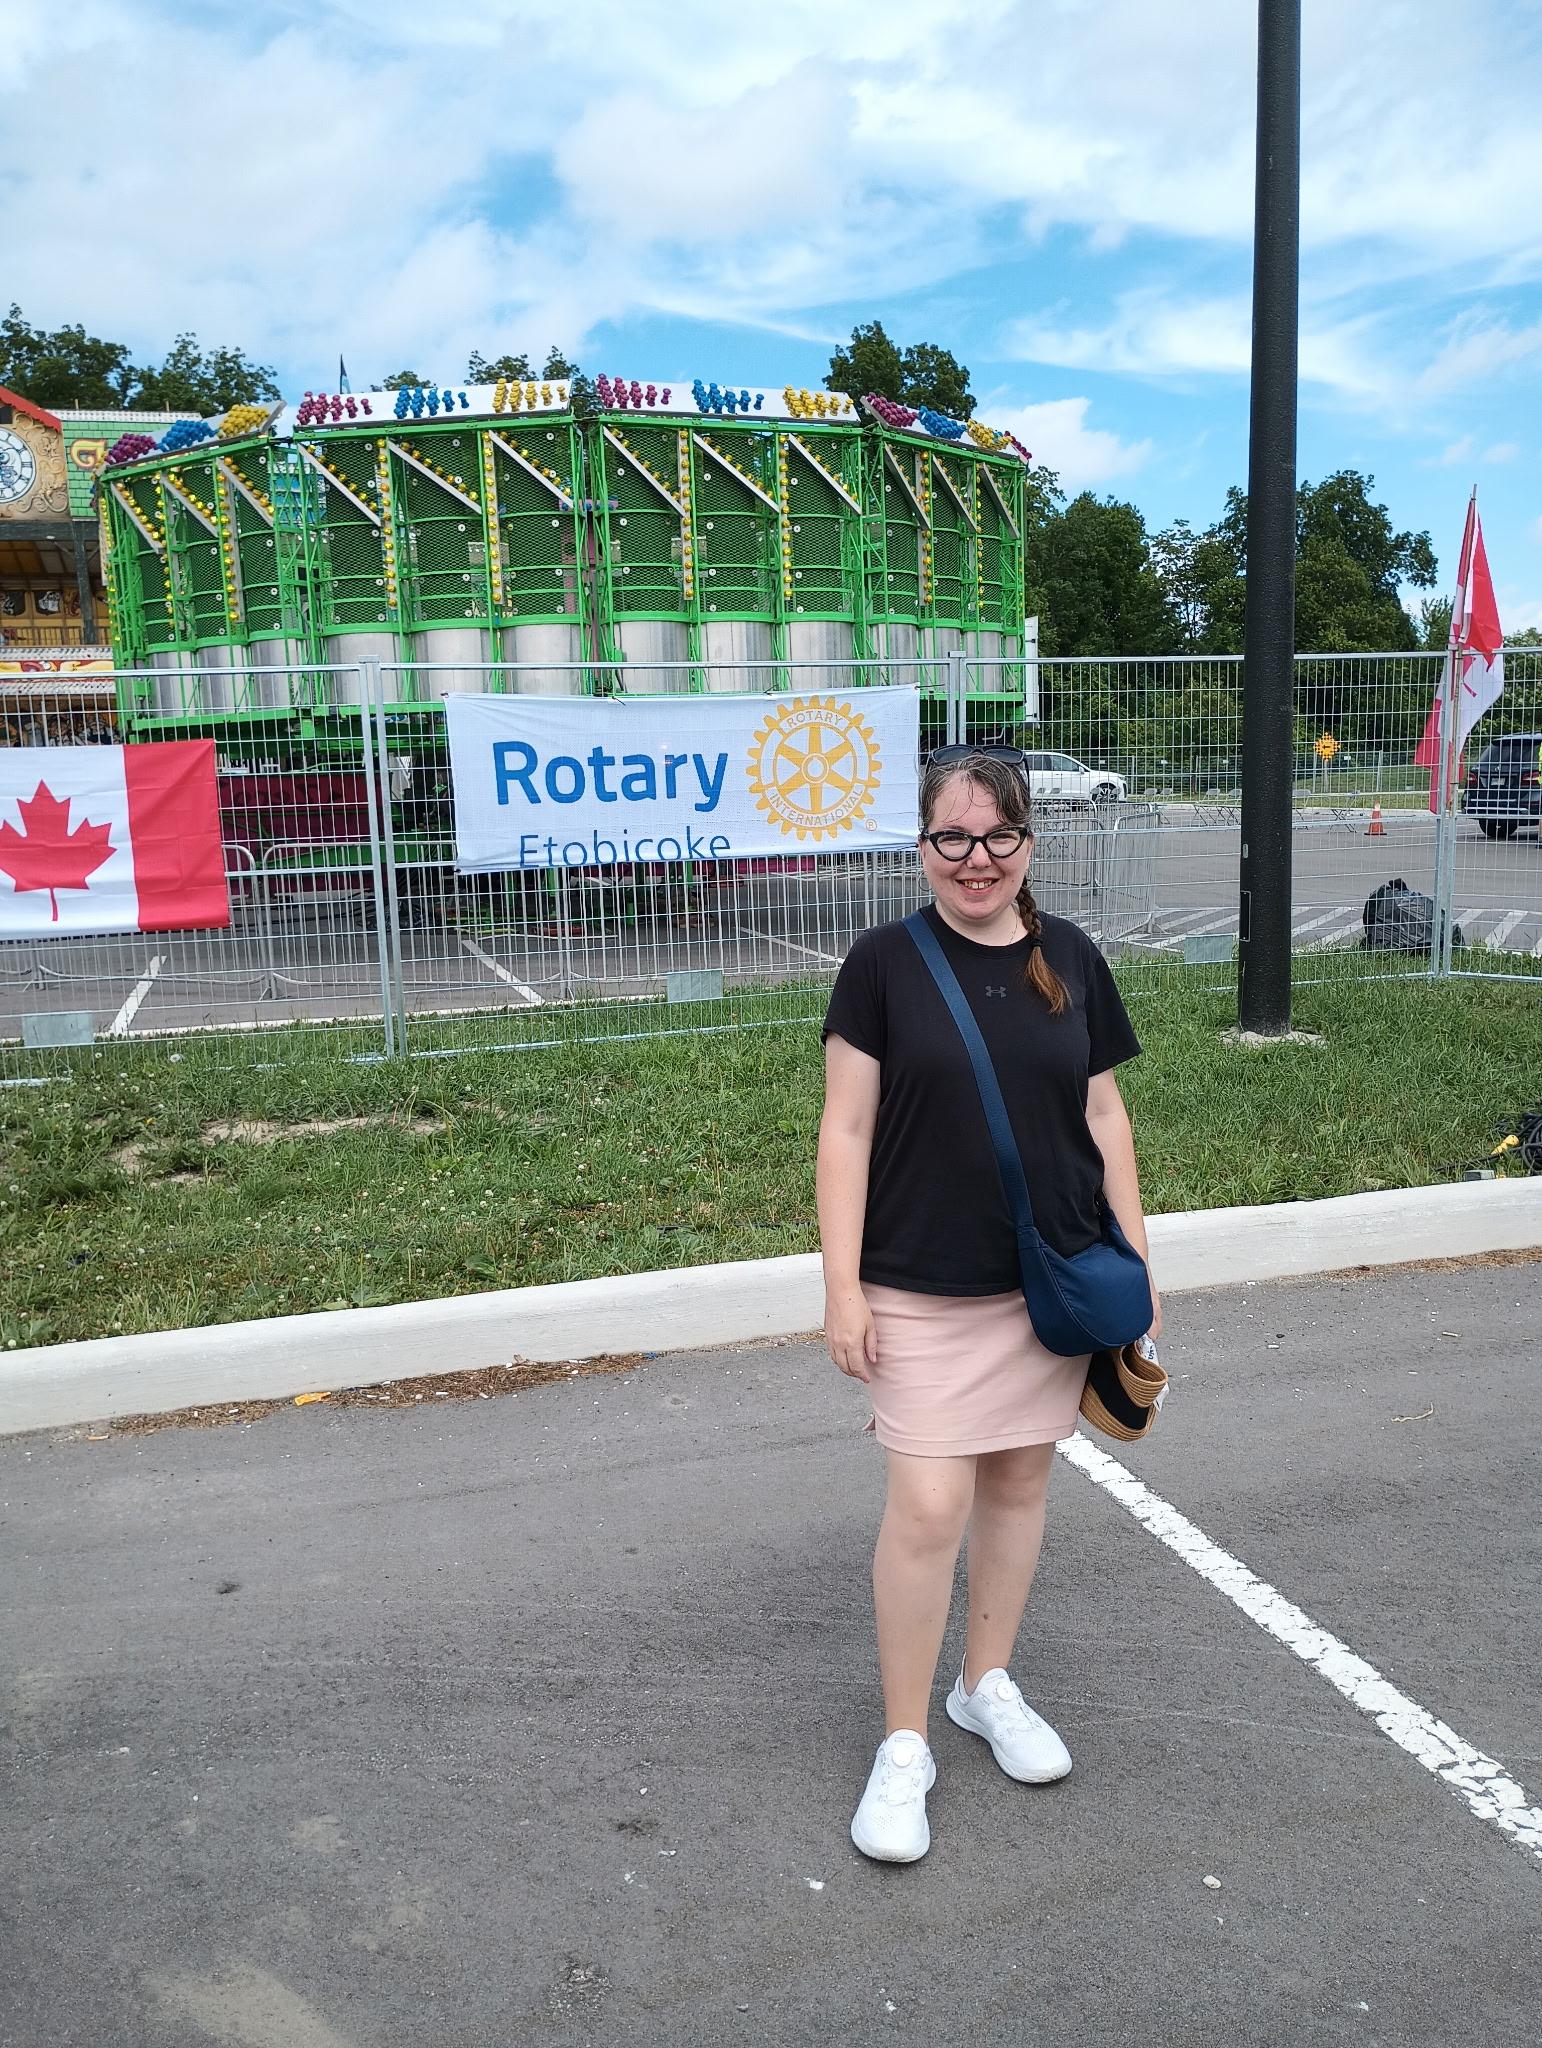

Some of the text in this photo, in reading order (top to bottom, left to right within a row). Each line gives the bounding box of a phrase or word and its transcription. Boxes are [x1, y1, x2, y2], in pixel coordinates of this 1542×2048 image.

[785, 710, 844, 729] ROTARY
[493, 741, 728, 812] Rotary
[769, 789, 864, 826] INTERNATIONAL
[519, 825, 731, 868] Etobicoke
